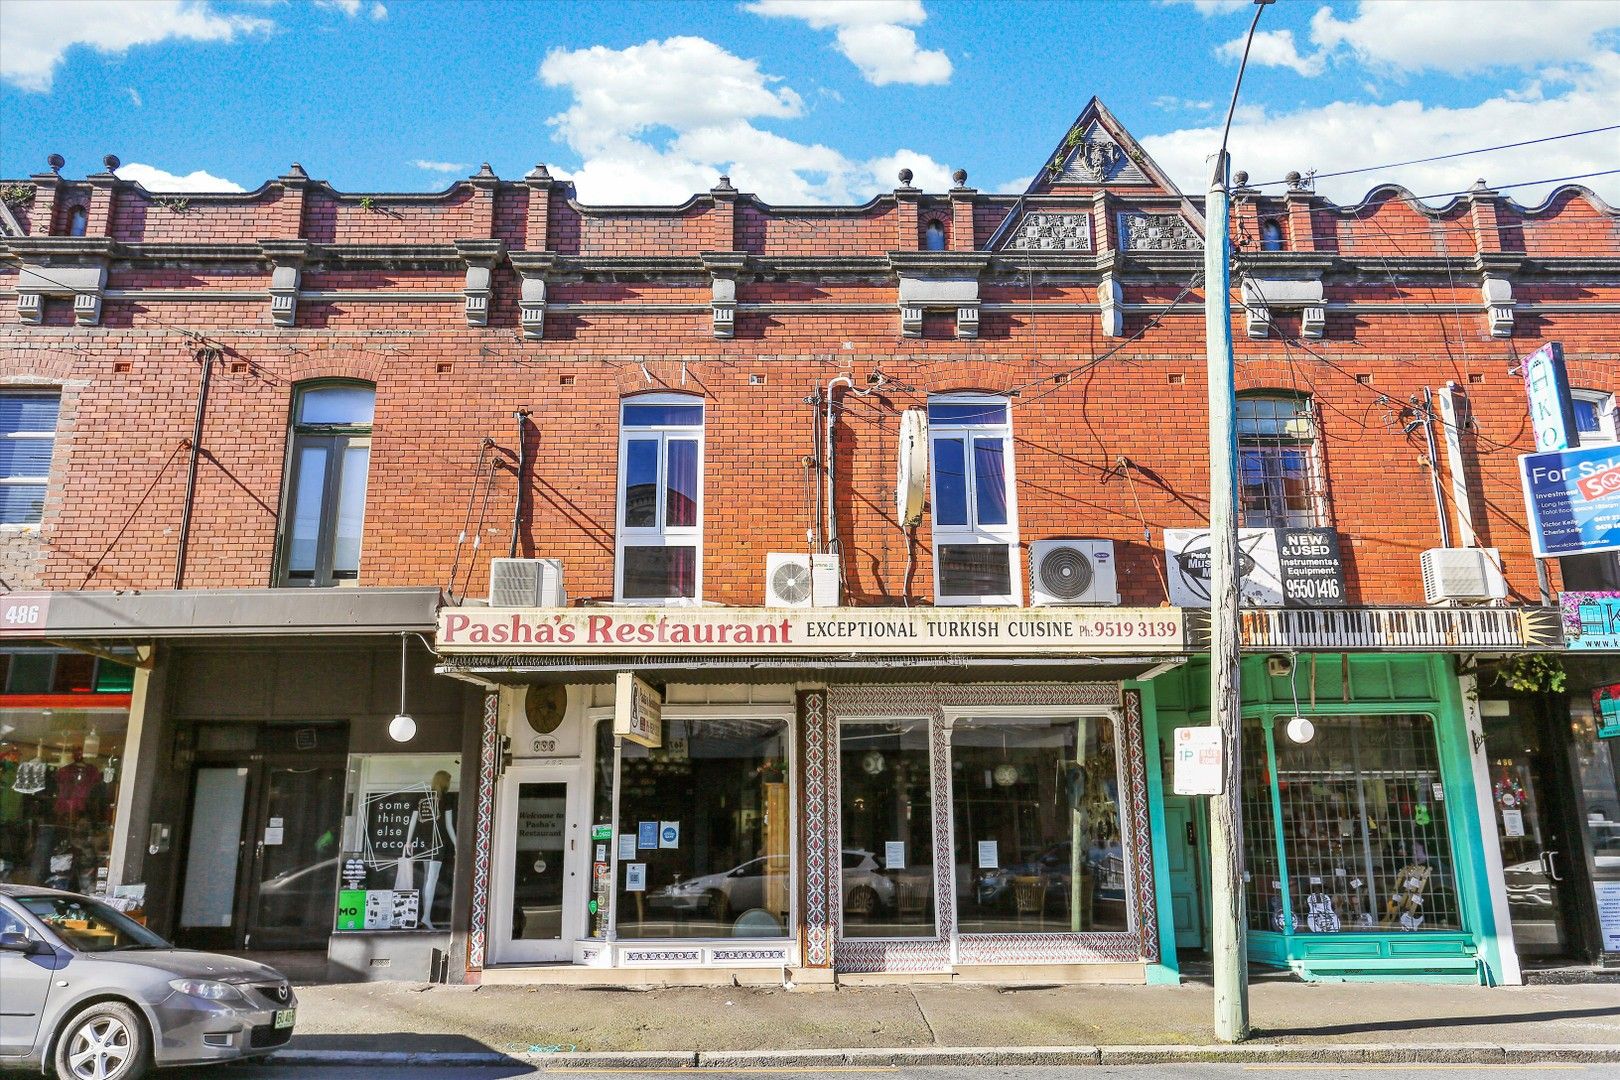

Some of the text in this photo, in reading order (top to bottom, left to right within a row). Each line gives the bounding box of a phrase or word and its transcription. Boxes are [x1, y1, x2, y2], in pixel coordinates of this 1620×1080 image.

[1532, 458, 1620, 484] For Sal
[1535, 488, 1579, 499] Investment
[1288, 535, 1323, 546] NEW
[5, 605, 40, 624] 486
[444, 614, 793, 643] Pasha's Restaurant
[806, 621, 918, 639] EXCEPTIONAL
[927, 621, 999, 638] TURKISH
[1007, 621, 1074, 638] CUISINE
[1094, 621, 1134, 638] 9519
[1137, 621, 1178, 638] 3139
[1179, 750, 1194, 761] 1P
[378, 802, 410, 810] some
[377, 812, 410, 826] thing
[519, 811, 565, 820] Welcome to
[526, 820, 556, 828] Pasha's
[376, 825, 402, 836] else
[519, 829, 562, 838] Restaurant
[375, 837, 425, 849] recods
